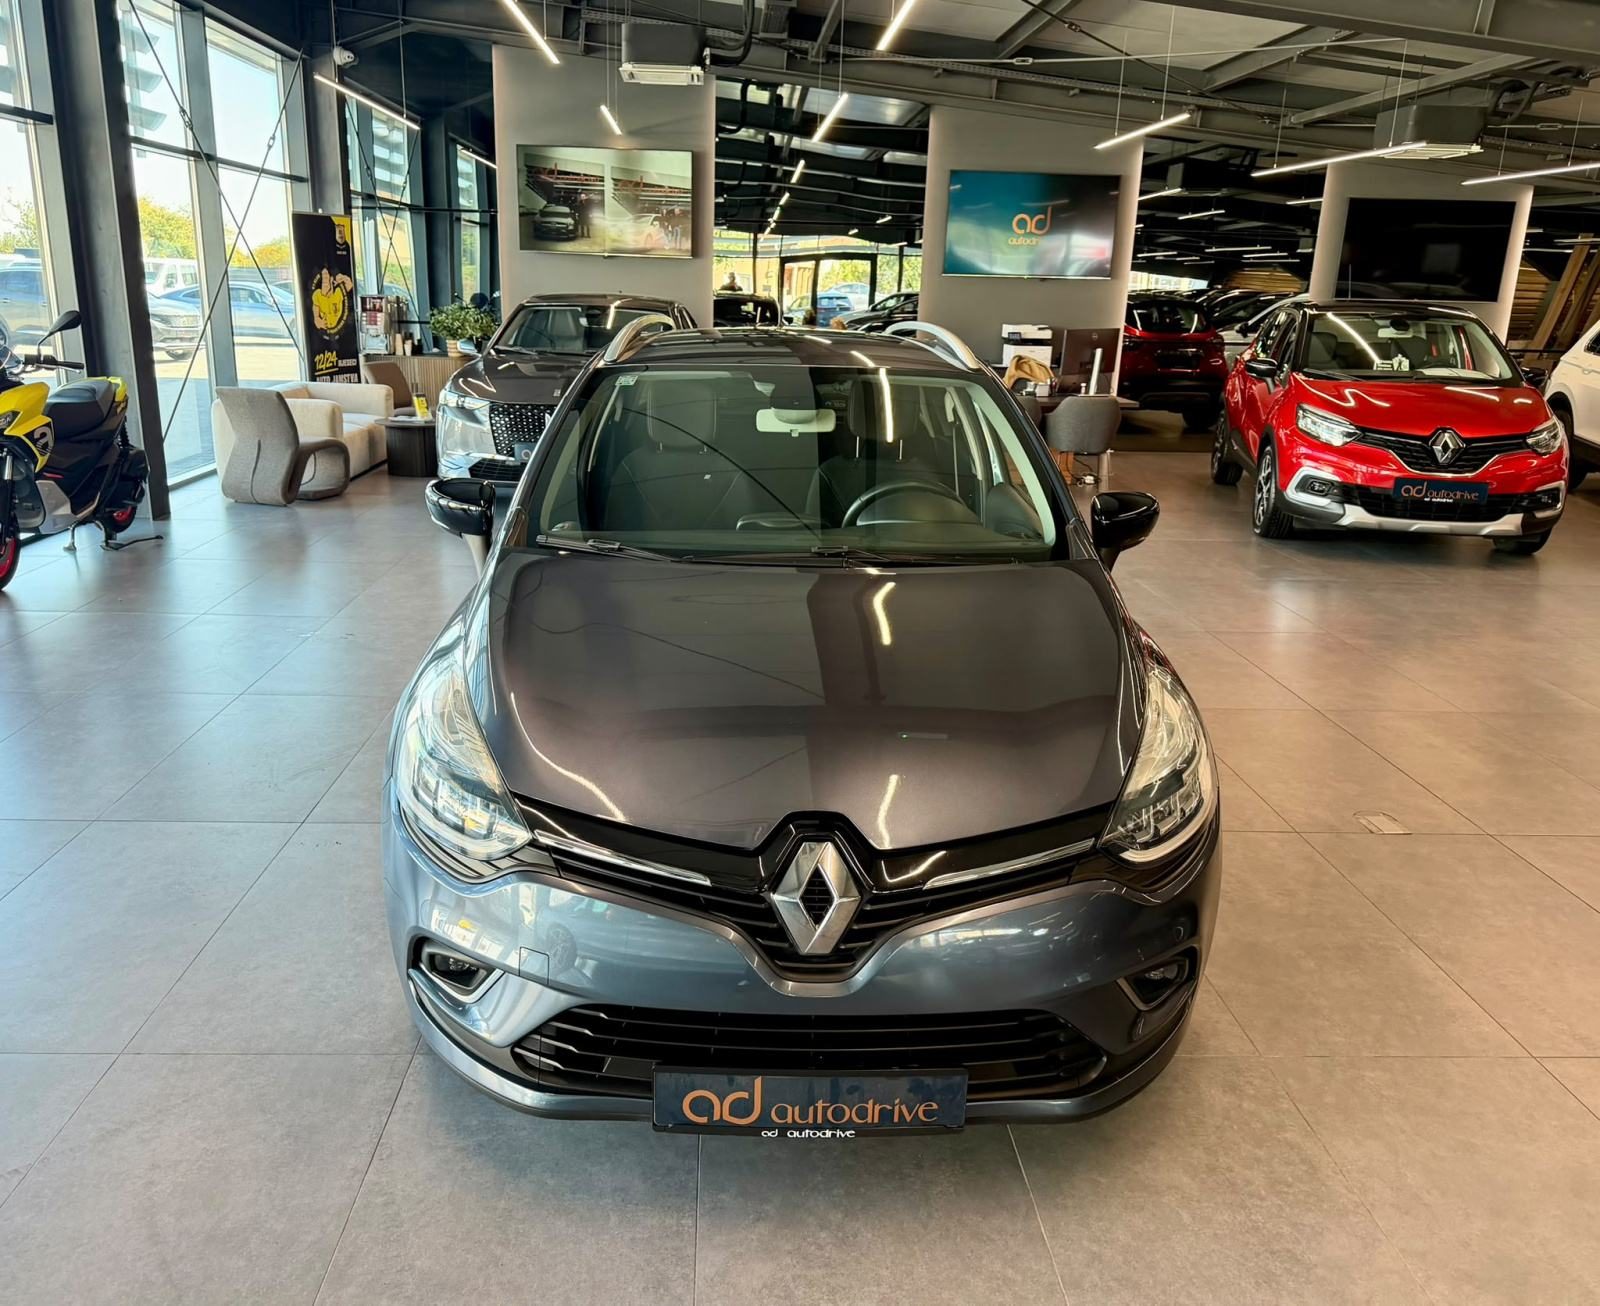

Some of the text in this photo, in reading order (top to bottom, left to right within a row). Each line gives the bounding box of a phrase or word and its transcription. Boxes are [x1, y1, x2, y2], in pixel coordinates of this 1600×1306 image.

[1012, 205, 1052, 236] ad
[315, 350, 338, 370] 12/24
[1401, 481, 1479, 500] ad autodrive
[682, 1075, 939, 1125] ad autodrive
[761, 1128, 857, 1138] ad autodrive
